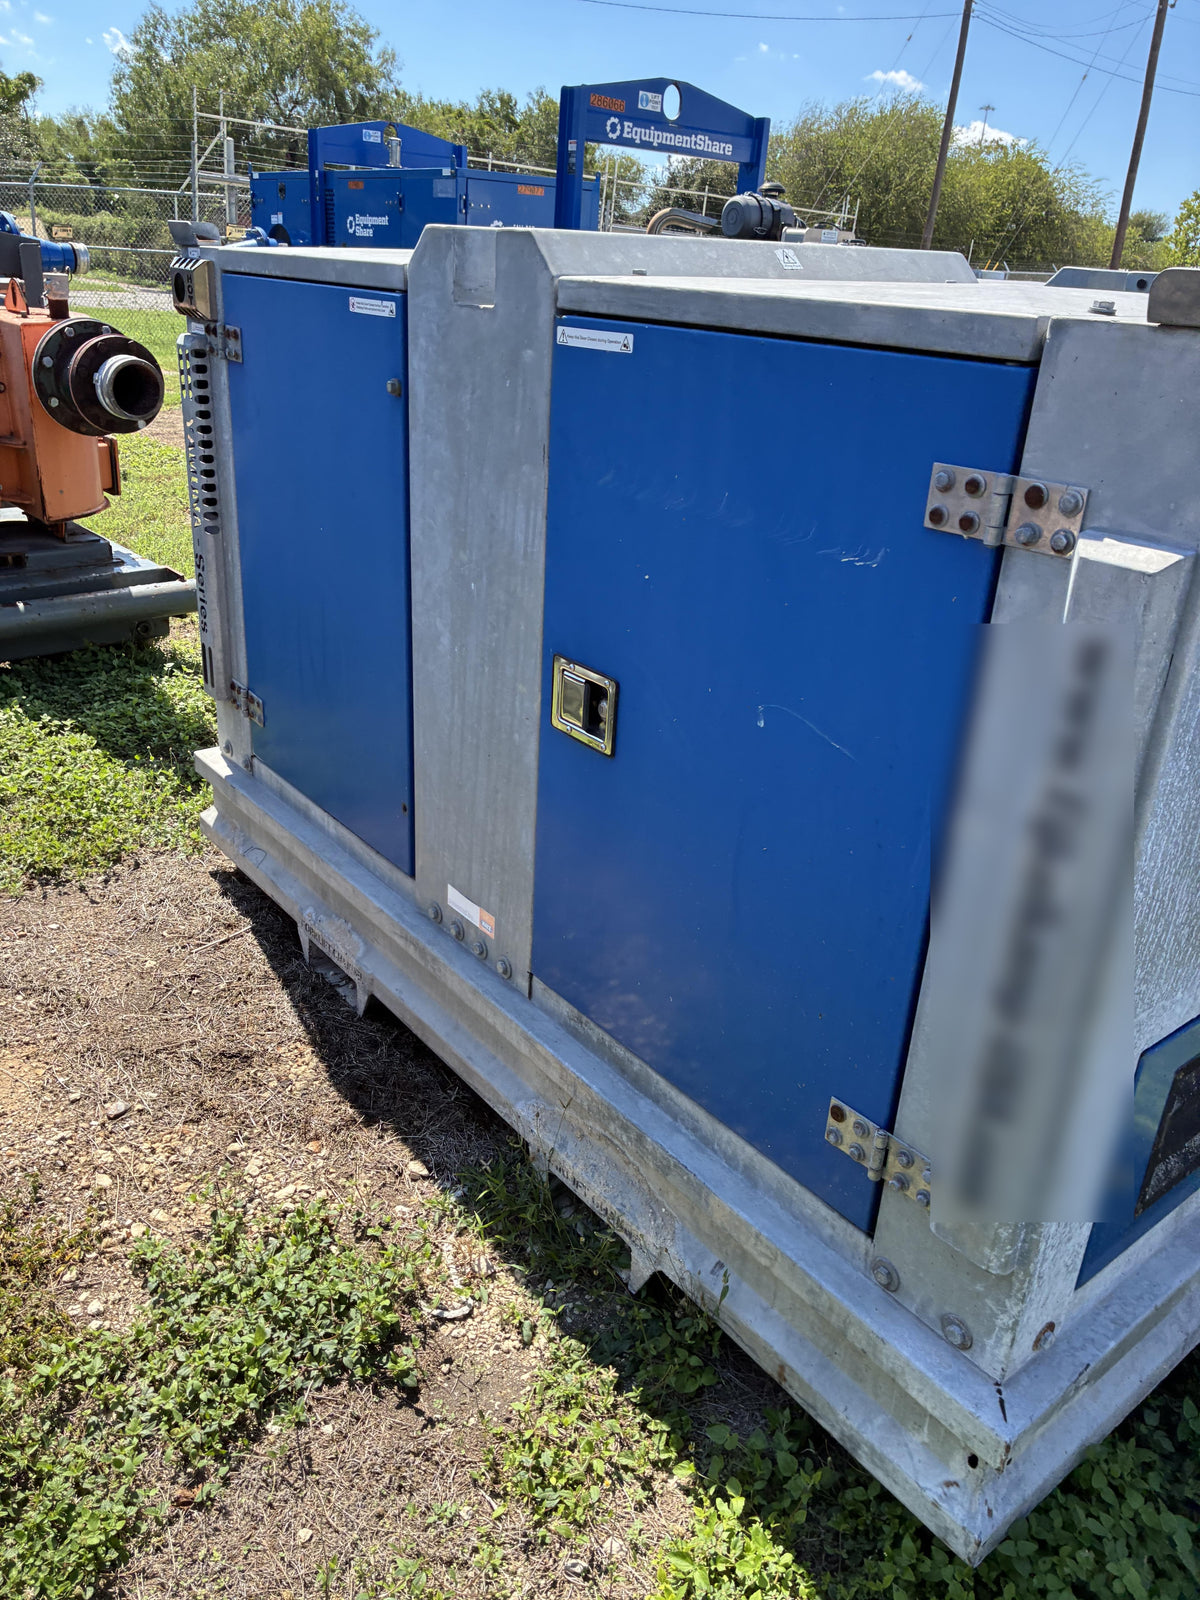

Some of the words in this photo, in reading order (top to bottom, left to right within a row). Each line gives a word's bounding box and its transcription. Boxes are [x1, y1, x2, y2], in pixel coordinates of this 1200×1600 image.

[623, 121, 733, 156] EquipmentShare
[355, 213, 389, 227] Equipment
[355, 226, 373, 237] Share
[195, 553, 208, 634] Series
